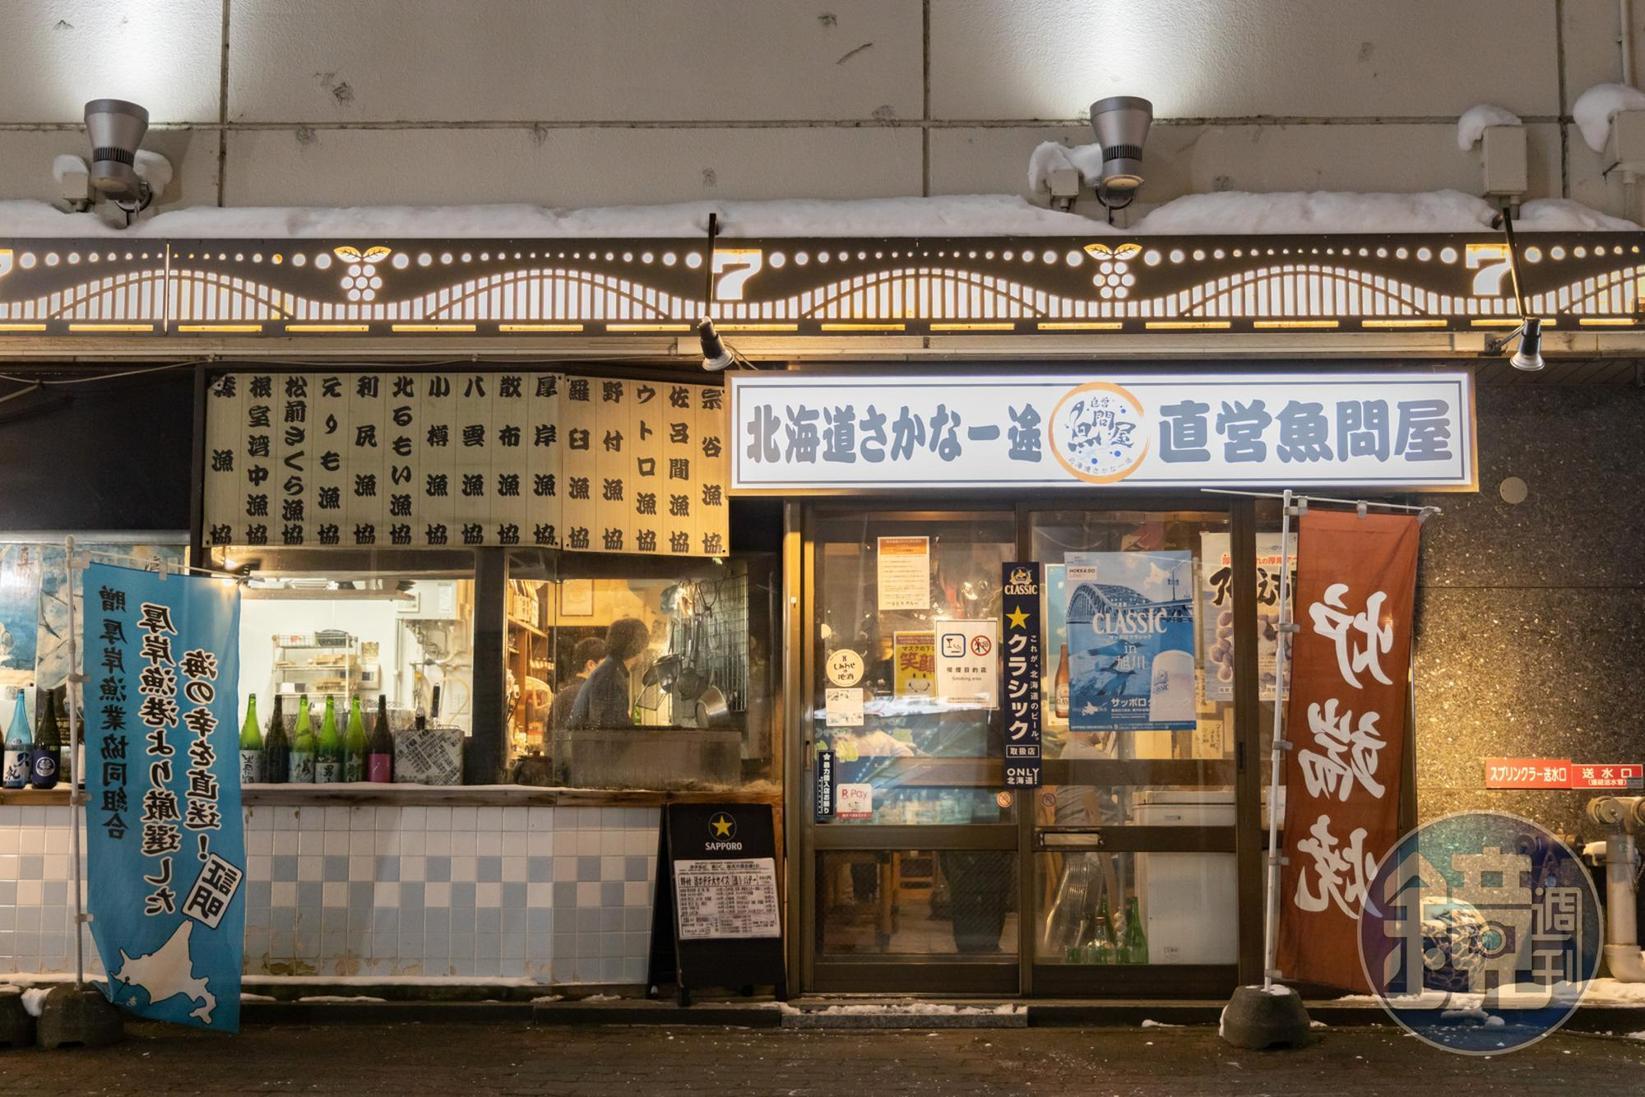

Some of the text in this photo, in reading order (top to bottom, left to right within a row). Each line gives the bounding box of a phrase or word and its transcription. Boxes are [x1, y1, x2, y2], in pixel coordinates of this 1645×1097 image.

[712, 248, 763, 301] 7
[245, 375, 272, 545] 根室湾中漁協
[281, 375, 308, 545] 松前さくら漁協
[317, 376, 342, 545] えりも漁協
[353, 375, 379, 545] 利尻漁協
[389, 375, 415, 545] 北るもい漁協
[425, 375, 450, 545] 小樽漁協
[461, 375, 486, 545] 八雲漁協
[497, 375, 522, 545] 散布漁協
[533, 375, 558, 545] 厚岸漁協
[568, 378, 590, 550] 羅臼漁協
[602, 381, 624, 551] 野付漁協
[636, 384, 657, 552] ウトロ漁協
[669, 385, 690, 553] 佐呂間漁協
[701, 388, 723, 554] 宗谷漁協
[746, 403, 1042, 464] 北海道さかな一途
[1158, 399, 1453, 463] 直営魚問屋
[1005, 584, 1038, 595] CLASSIC
[1092, 608, 1168, 635] CLASSIC
[1124, 643, 1137, 654] in
[1007, 634, 1028, 740] クラシック
[1010, 747, 1035, 756] 取扱店
[1029, 635, 1040, 741] これが、北海道のビール。
[705, 842, 743, 850] SAPPORO
[1490, 767, 1567, 783] スプリンクラー送水口
[1582, 767, 1632, 779] 送水口
